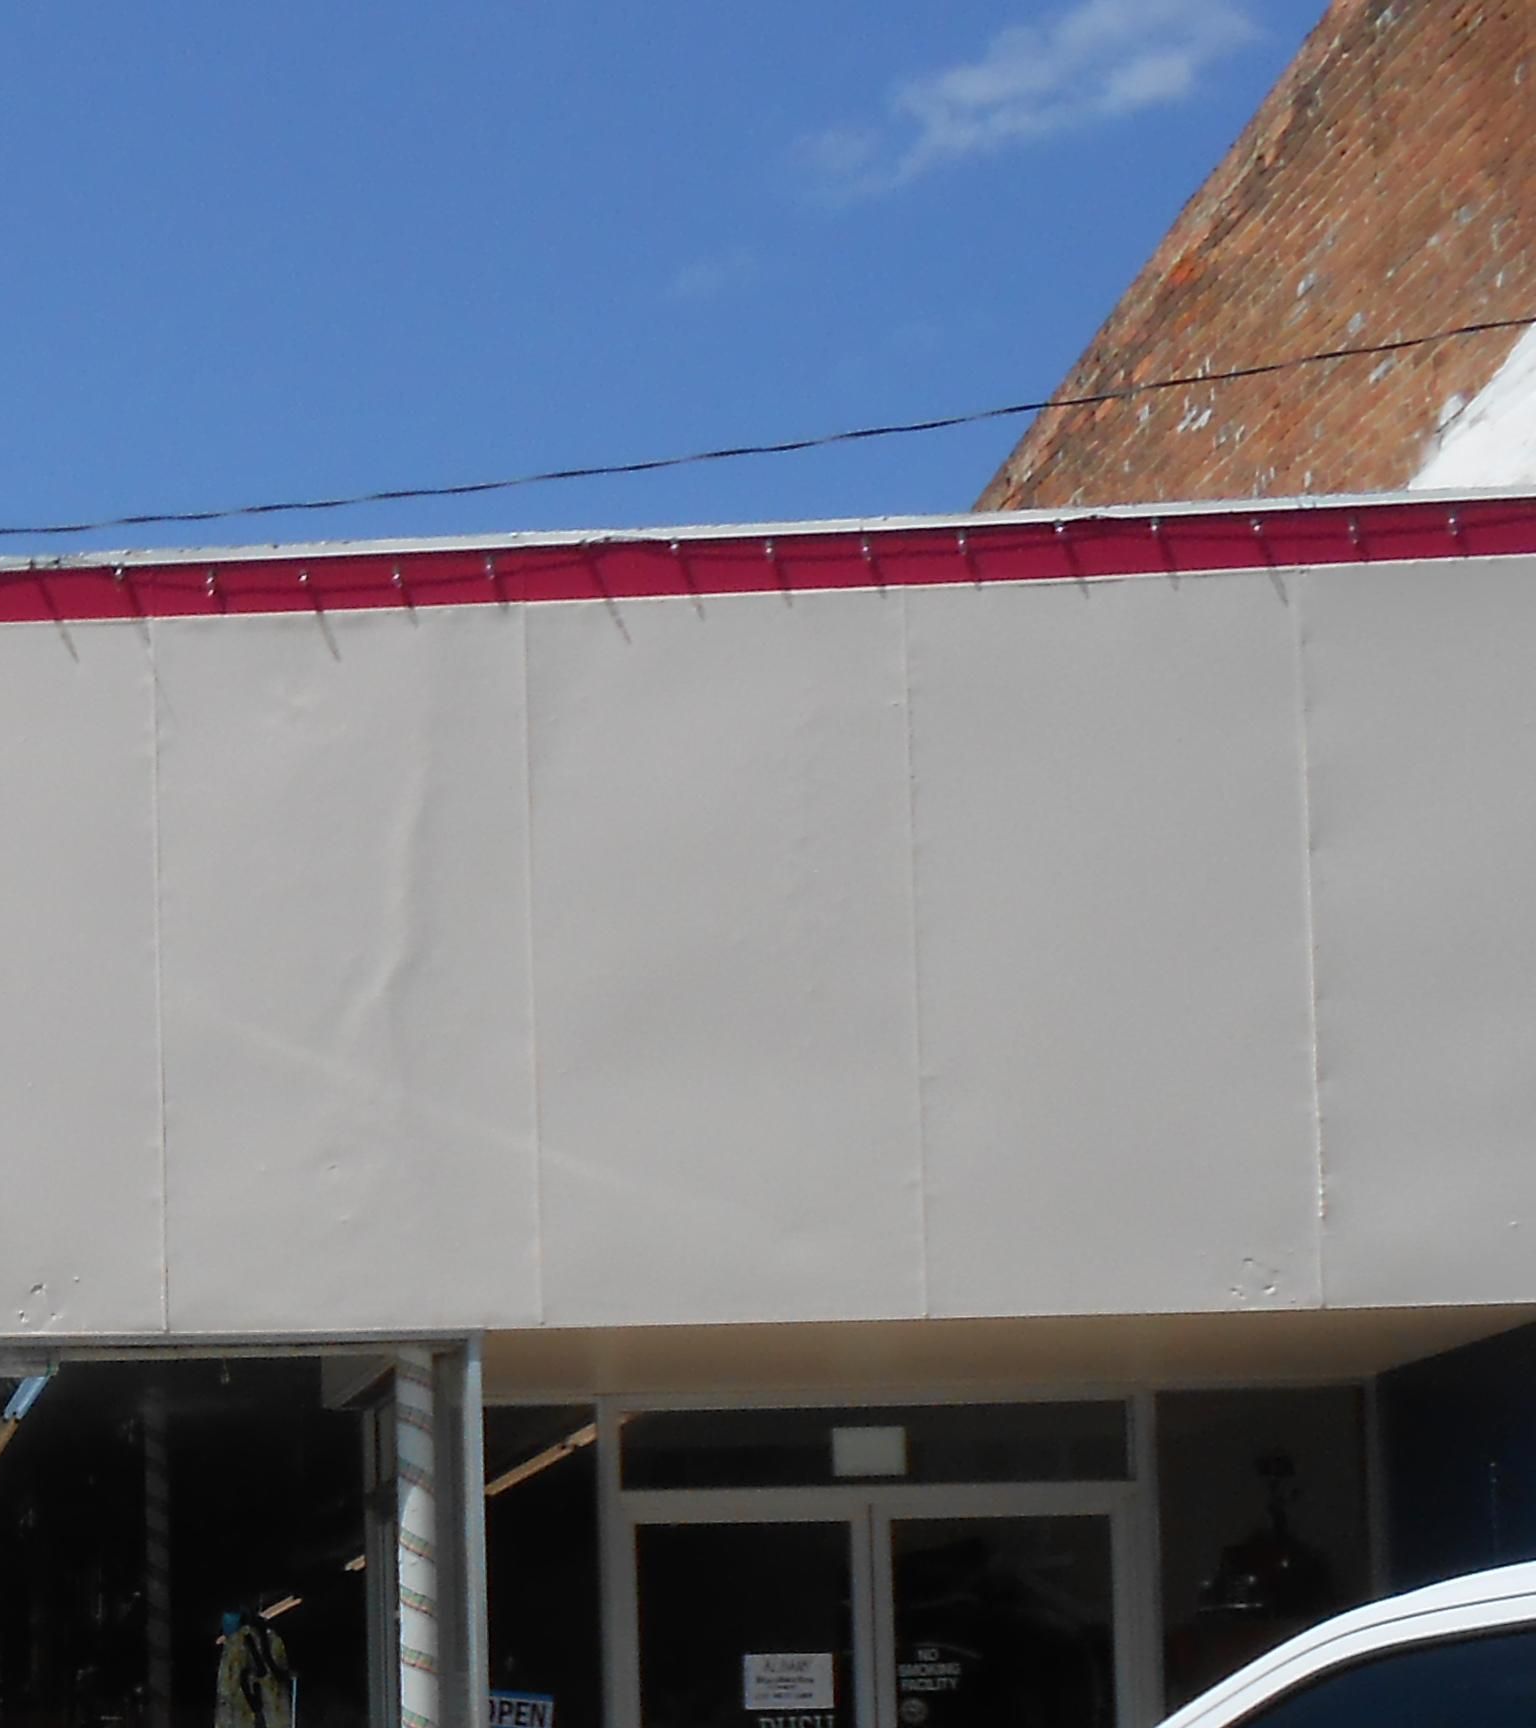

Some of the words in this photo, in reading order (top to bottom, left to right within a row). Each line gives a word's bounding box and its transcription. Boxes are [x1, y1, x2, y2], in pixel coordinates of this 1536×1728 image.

[917, 1648, 938, 1661] NO
[899, 1662, 961, 1677] SMOKING
[901, 1677, 957, 1691] FACILITY
